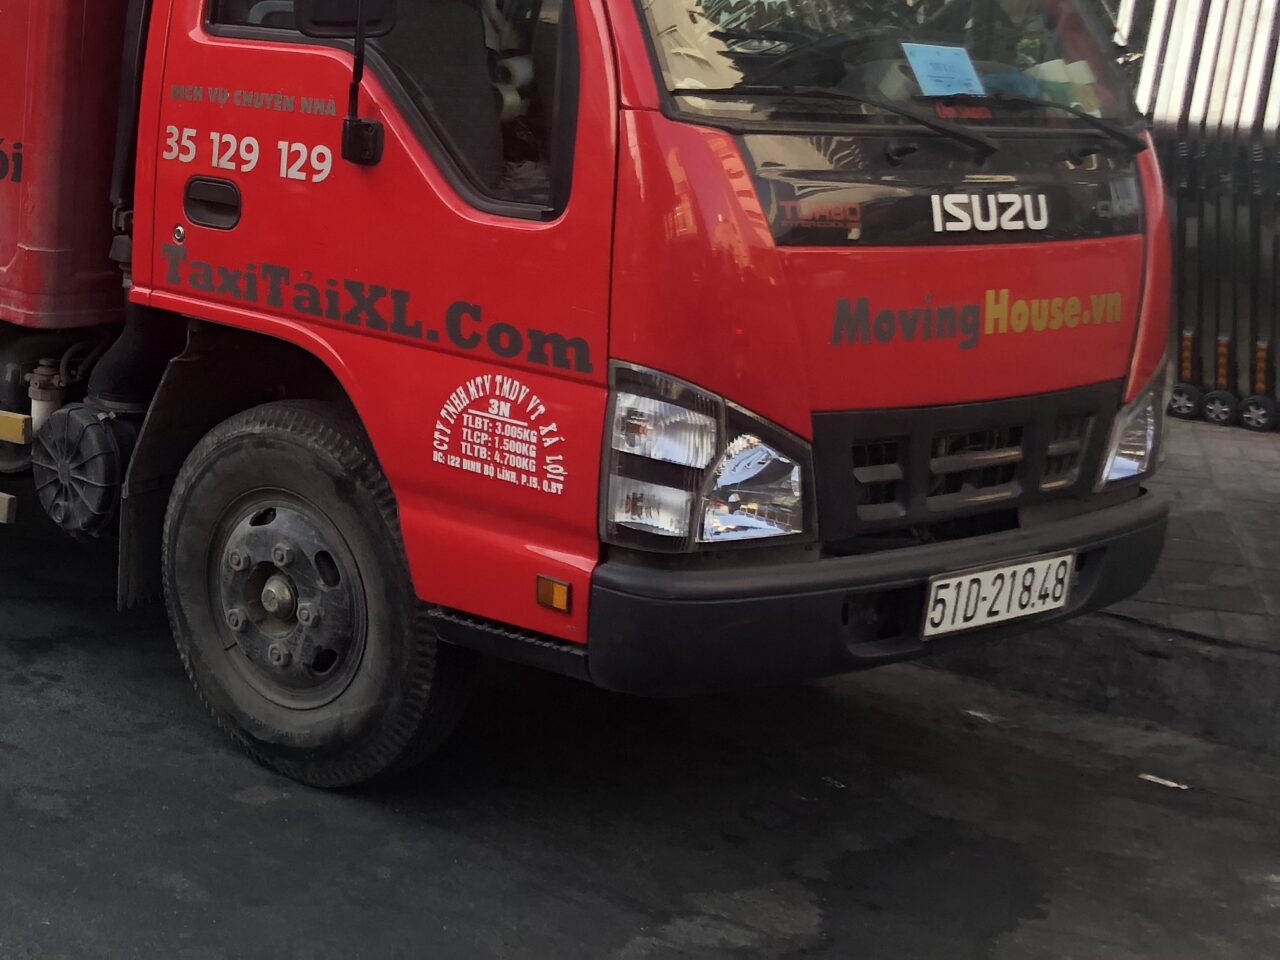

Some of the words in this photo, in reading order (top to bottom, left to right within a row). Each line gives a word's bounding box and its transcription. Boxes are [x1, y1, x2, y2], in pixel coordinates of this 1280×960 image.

[163, 125, 197, 163] 35
[209, 131, 260, 173] 129
[277, 140, 333, 183] 129
[930, 193, 1049, 232] ISUZU
[466, 374, 492, 400] MTV
[495, 374, 530, 405] TMDV
[440, 386, 470, 425] TNHH
[488, 398, 511, 418] 3N
[526, 395, 546, 421] VT
[433, 420, 451, 451] CTY
[461, 427, 492, 447] TLCP:
[493, 436, 537, 458] 1.500KG
[462, 413, 493, 433] TLBT:
[495, 422, 538, 444] 3.005KG
[539, 422, 566, 448] XÁ
[460, 441, 491, 461] TLTB:
[493, 450, 536, 473] 4.700KG
[543, 455, 568, 481] LỢI
[542, 480, 564, 495] Q.BT
[928, 558, 1069, 630] 51D-218.48
